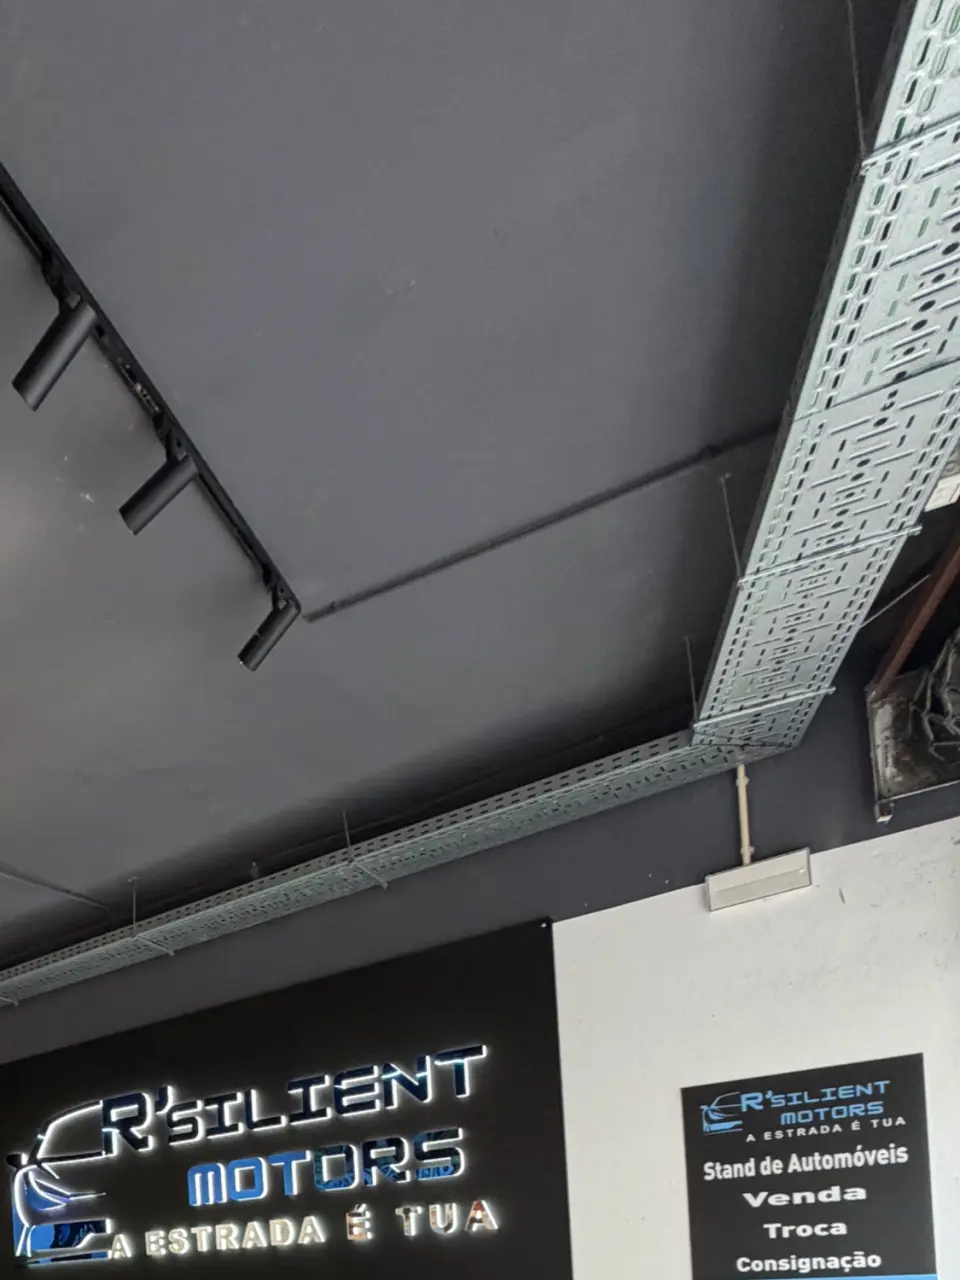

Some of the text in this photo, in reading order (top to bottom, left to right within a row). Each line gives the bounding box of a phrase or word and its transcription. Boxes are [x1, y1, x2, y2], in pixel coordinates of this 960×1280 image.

[780, 1101, 884, 1126] MOTORS
[746, 1116, 907, 1143] A ESTRADA É TUA
[187, 1127, 465, 1207] MOTORS
[703, 1143, 909, 1181] Stand de Automóveis
[742, 1185, 867, 1208] Venda
[109, 1199, 500, 1260] A ESTRADA É TUA
[763, 1221, 848, 1239] Troca
[736, 1251, 882, 1274] Consignação
